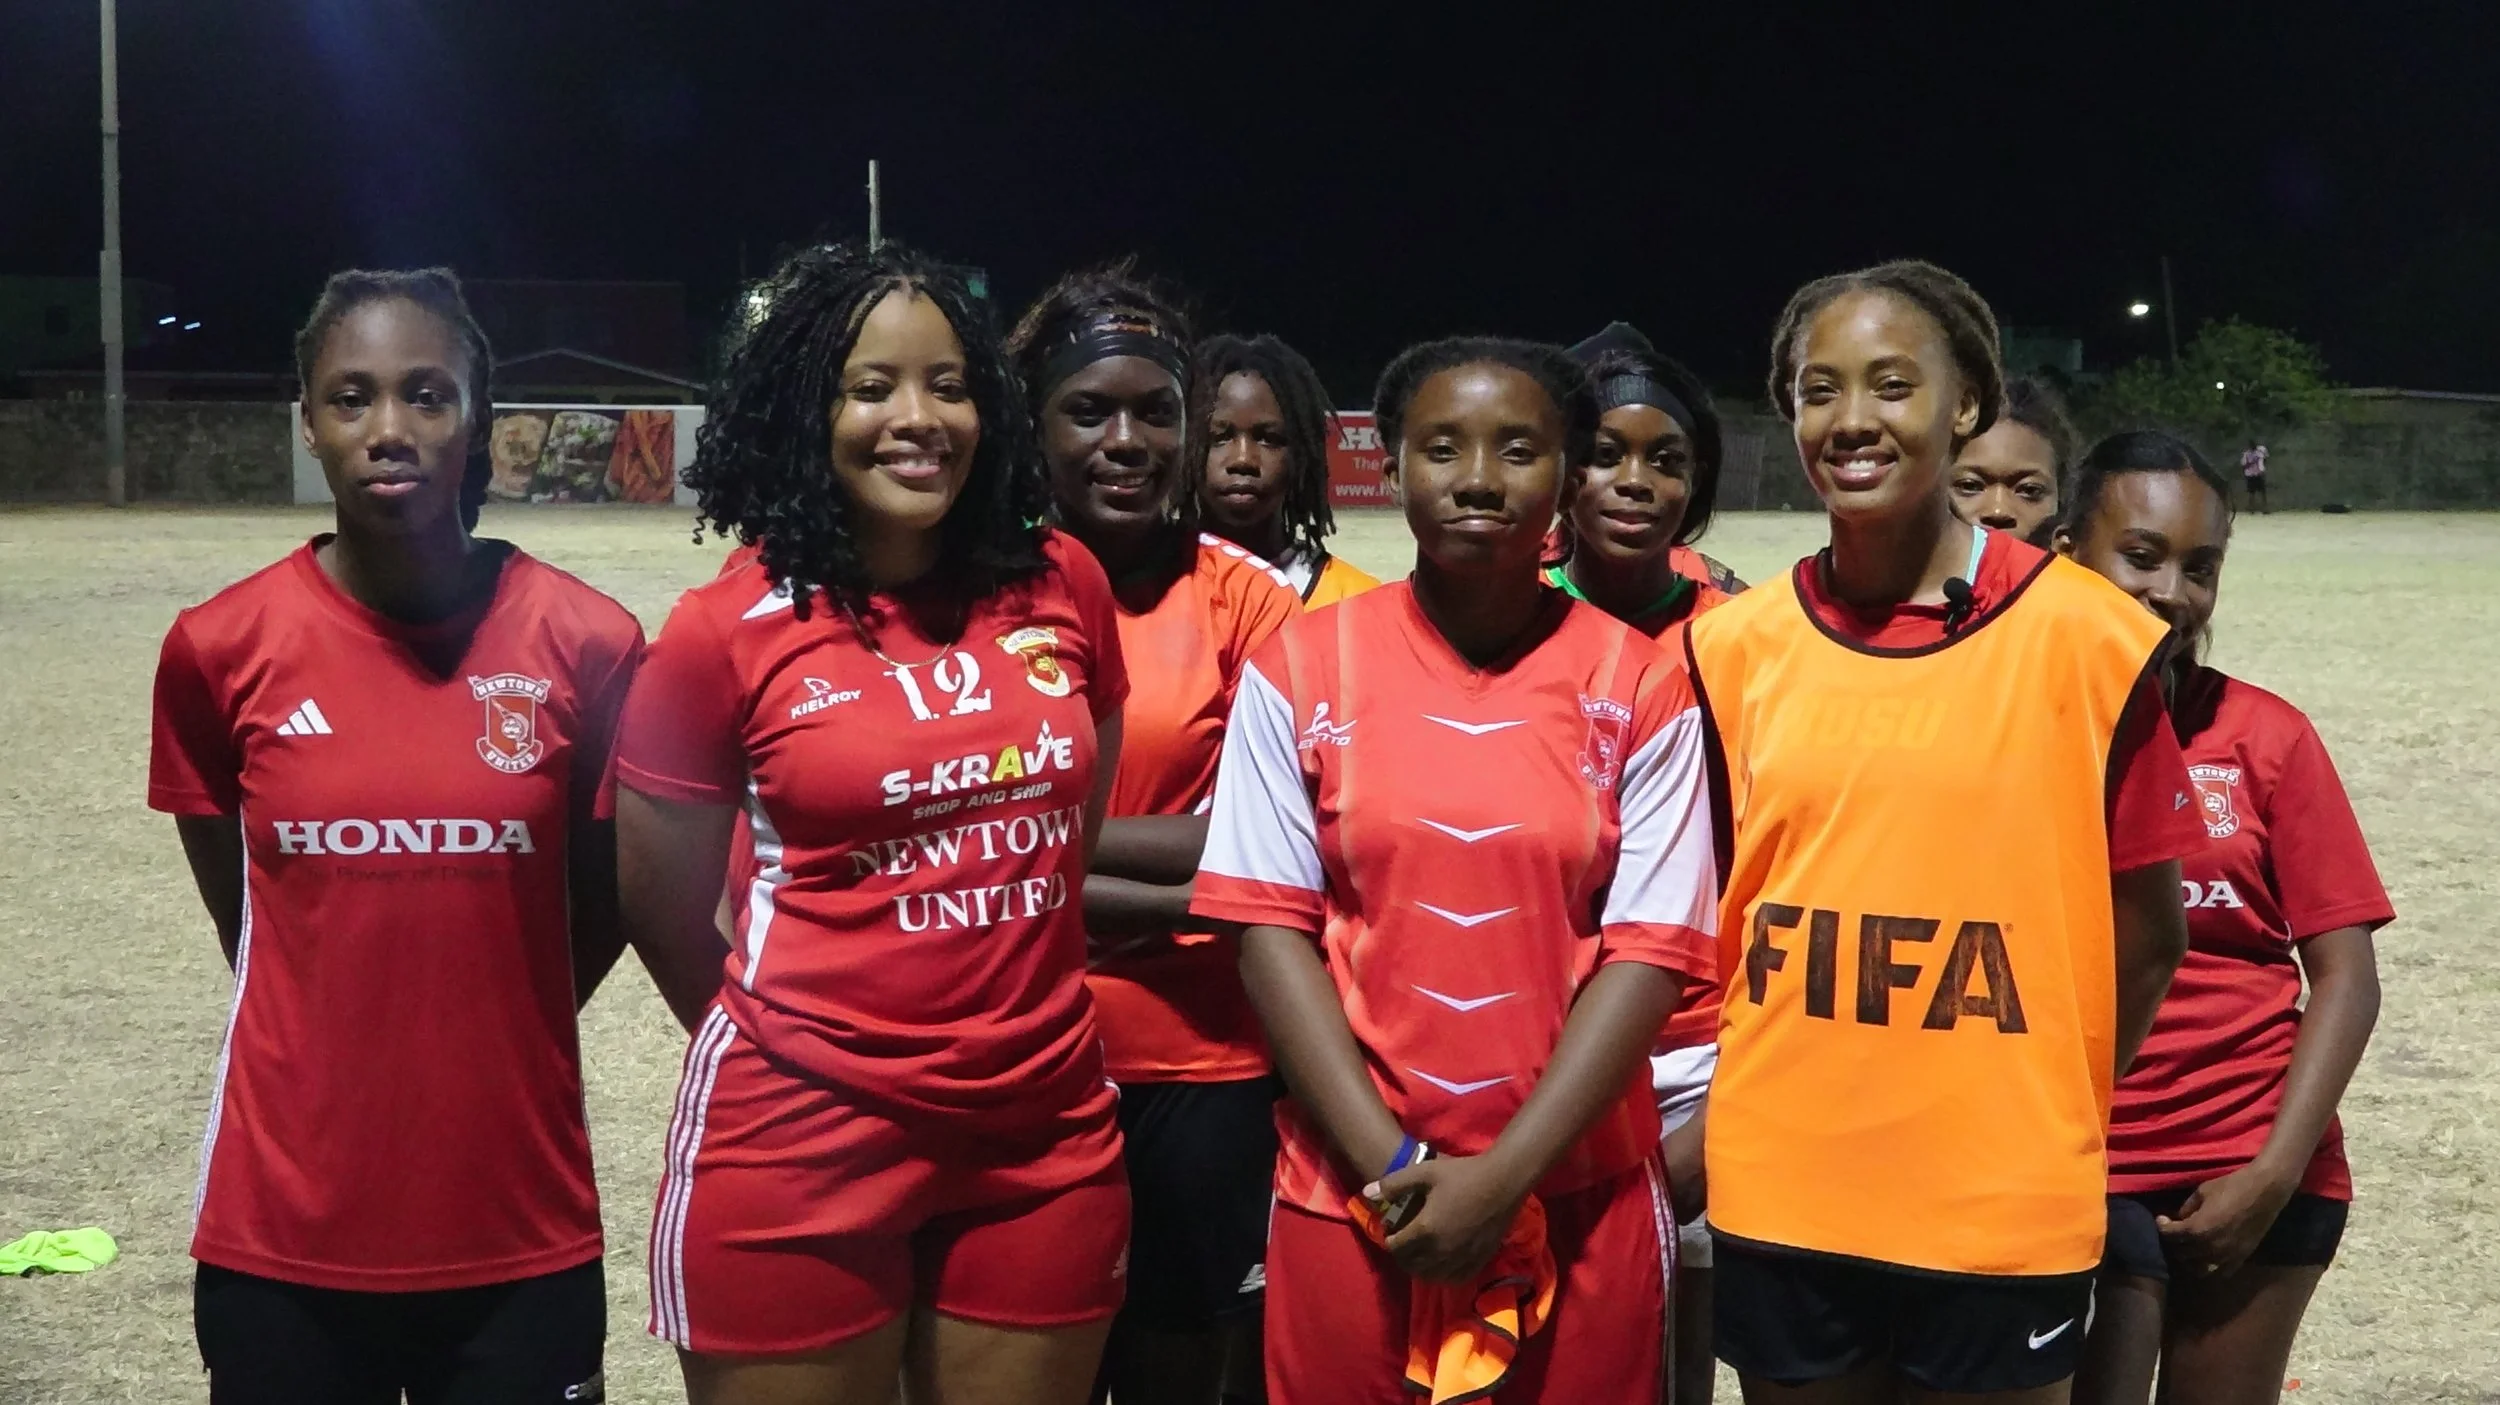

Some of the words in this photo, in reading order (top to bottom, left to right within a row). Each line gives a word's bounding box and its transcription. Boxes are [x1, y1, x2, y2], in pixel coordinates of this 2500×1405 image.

[476, 678, 545, 697] NEWTOWN
[790, 688, 862, 720] KIELROY
[883, 651, 992, 722] 12
[880, 722, 1074, 807] S-KRAVE
[912, 799, 961, 821] SHOP
[967, 790, 1007, 808] AND
[1011, 781, 1053, 801] SHIP
[273, 818, 536, 855] HONDA
[893, 872, 1067, 933] UNITED
[1746, 902, 2029, 1034] FIFA
